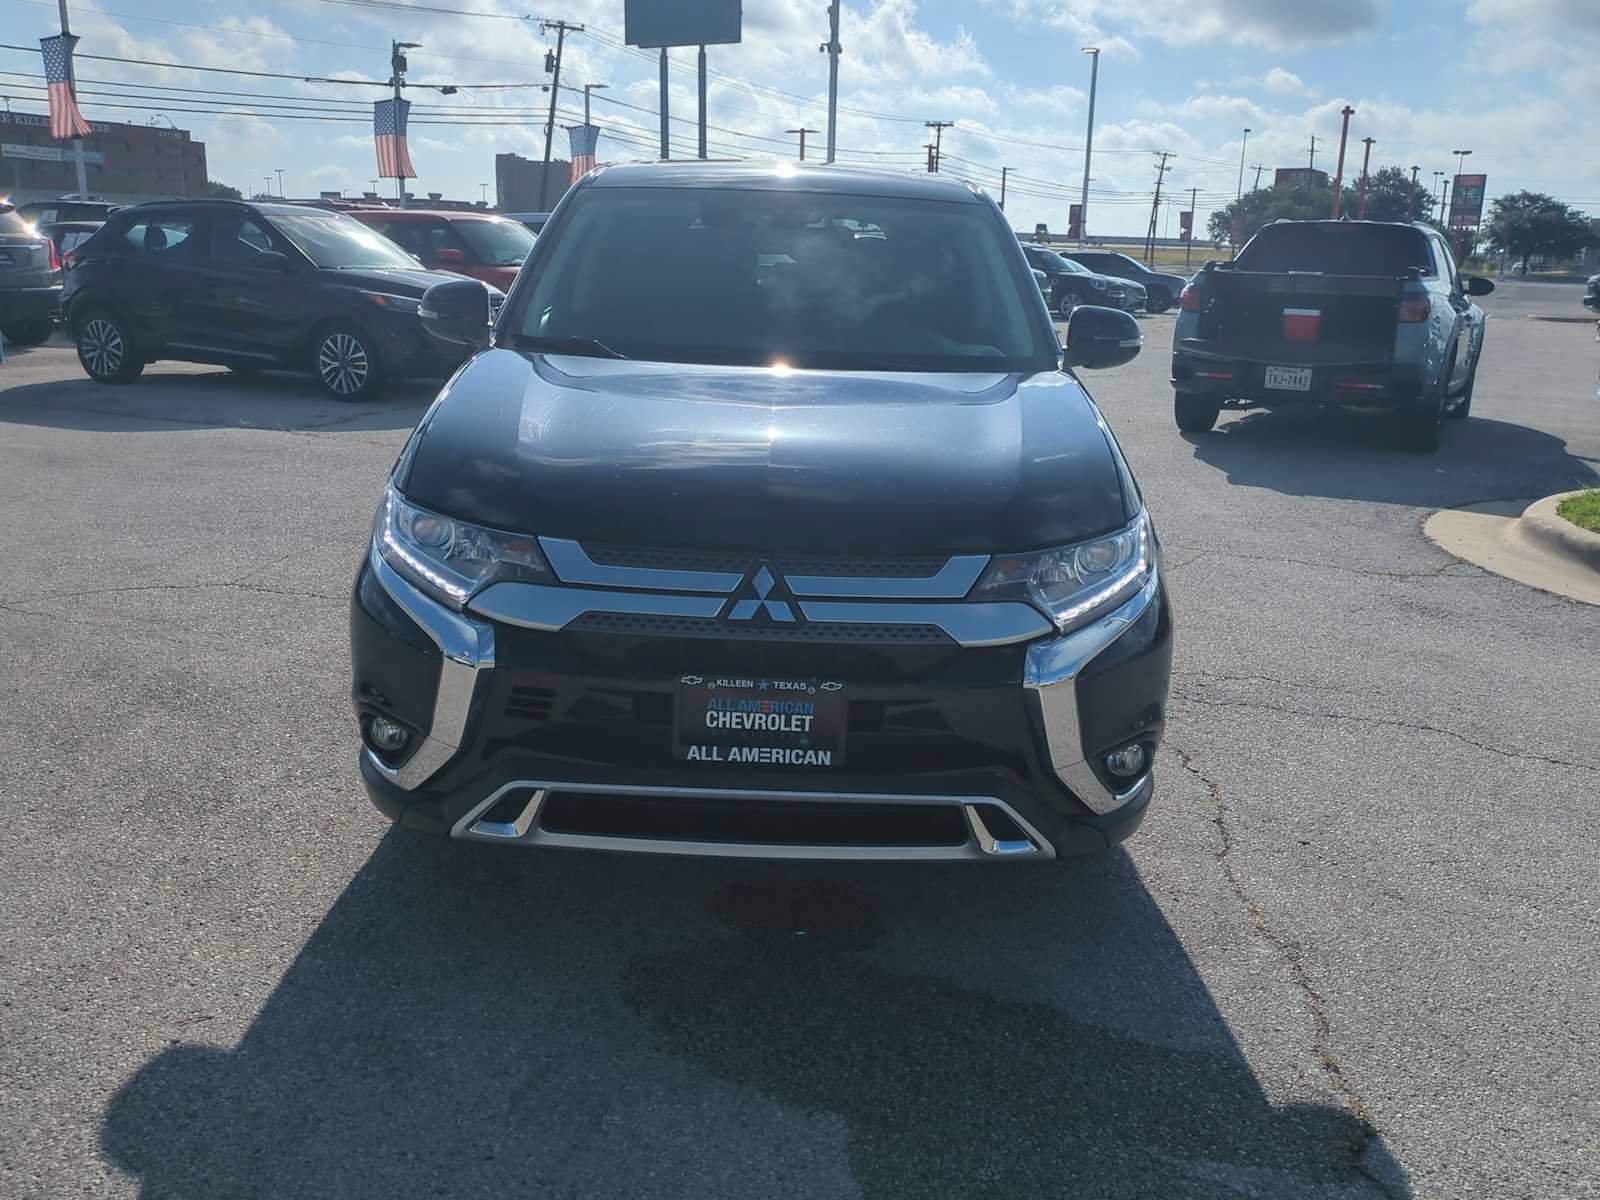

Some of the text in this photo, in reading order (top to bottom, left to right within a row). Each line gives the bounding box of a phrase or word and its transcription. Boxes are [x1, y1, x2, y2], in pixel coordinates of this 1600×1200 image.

[717, 679, 807, 690] KILLEEN TEXAS
[707, 698, 815, 714] ALL AMERICAN
[705, 710, 814, 732] CHEVROLET
[687, 745, 832, 766] ALL AMERICAN
